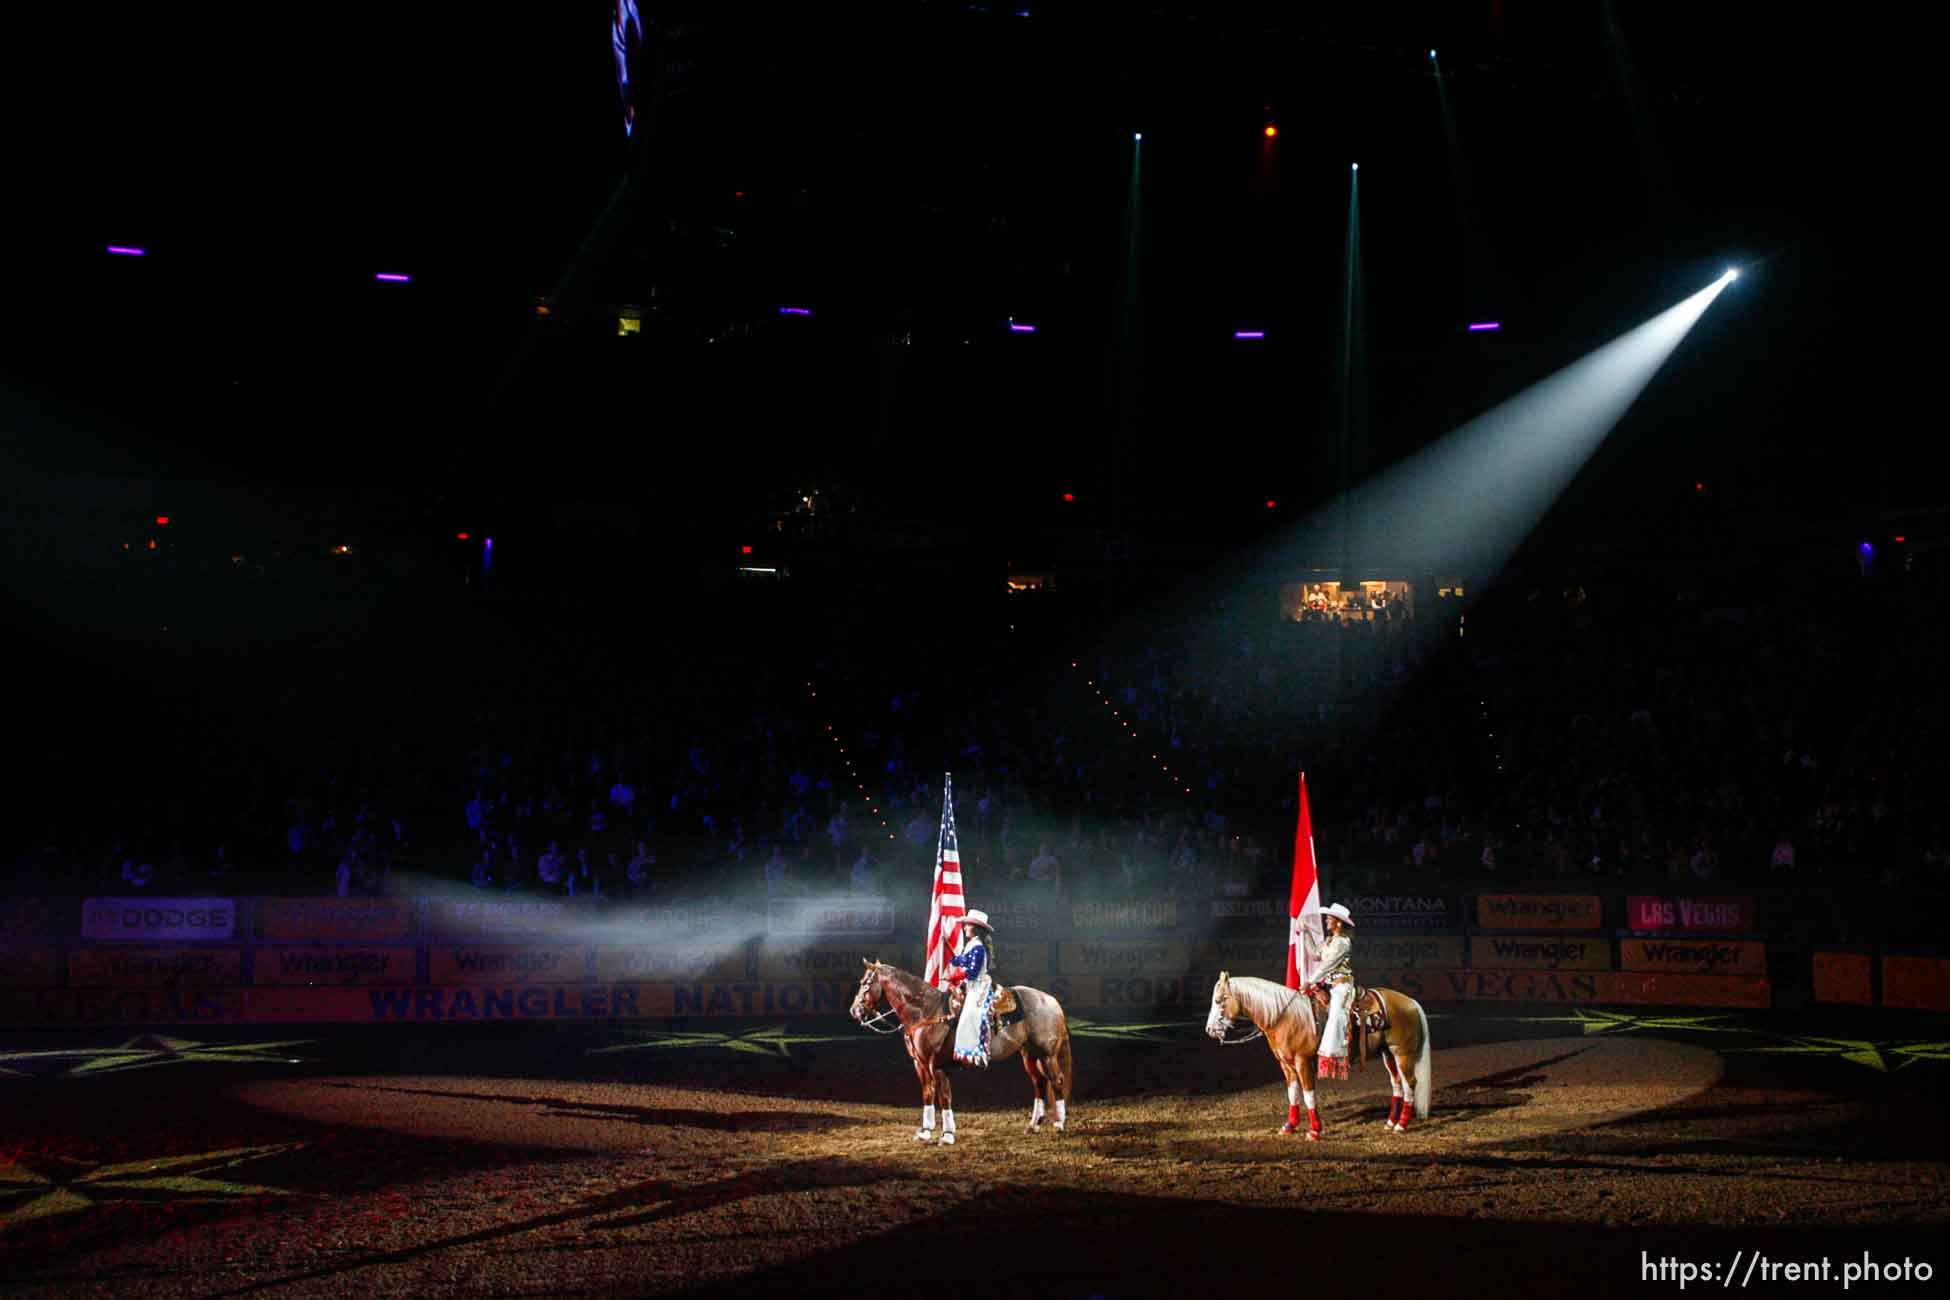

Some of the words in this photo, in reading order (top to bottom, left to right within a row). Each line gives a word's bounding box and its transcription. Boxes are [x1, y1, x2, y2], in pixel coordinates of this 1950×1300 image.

[121, 908, 228, 929] DODGE
[1342, 896, 1447, 911] MONTANA
[280, 949, 391, 983] Wrangler
[455, 948, 562, 982] Wrangler
[1079, 942, 1169, 975] Wrangler
[1492, 938, 1588, 969] Wrangler
[1641, 942, 1742, 975] Wrangler
[369, 986, 640, 1018] WRANGLER
[674, 982, 846, 1012] NATION
[1101, 977, 1211, 1004] RODE
[1448, 972, 1599, 1000] VEGAS
